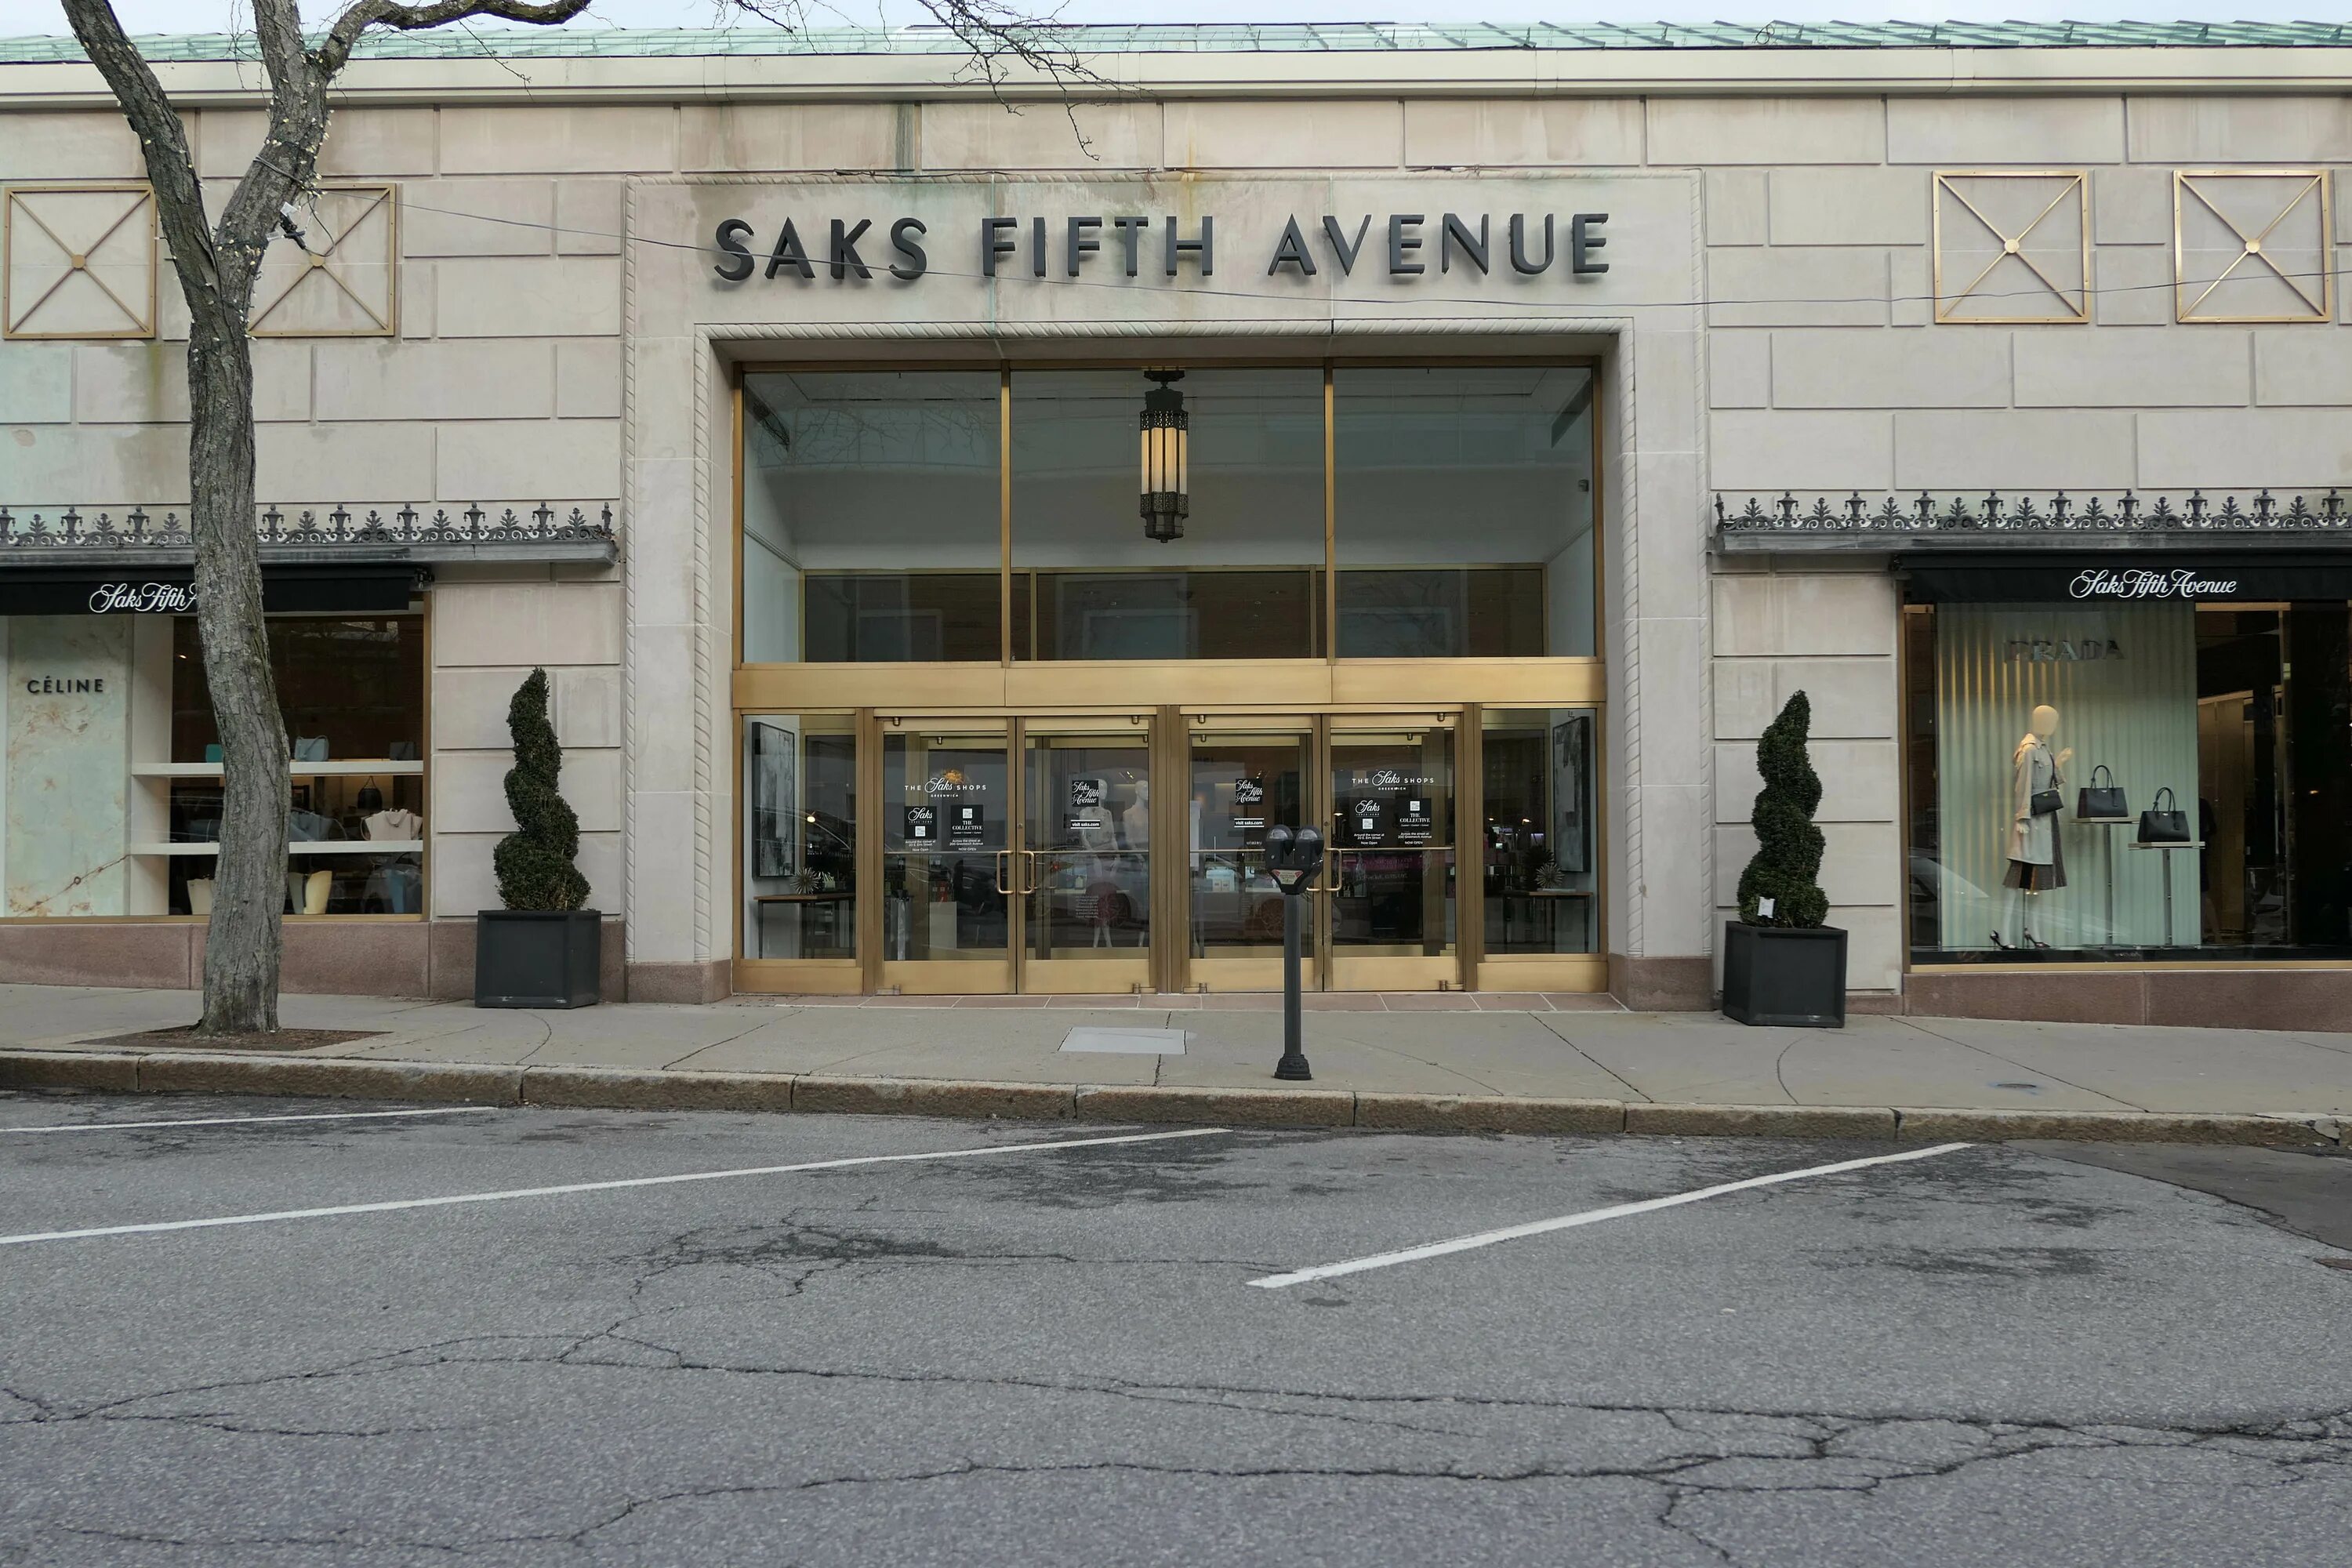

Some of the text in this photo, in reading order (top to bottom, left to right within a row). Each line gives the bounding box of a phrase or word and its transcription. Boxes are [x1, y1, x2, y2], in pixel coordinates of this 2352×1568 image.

[713, 212, 1610, 281] SAKS FIFTH AVENUE
[2069, 569, 2237, 598] Saks Fifth Avenue
[89, 583, 143, 613] Saks
[135, 583, 187, 612] Fifth
[27, 675, 103, 694] CÉLINE
[924, 777, 953, 793] Saks
[1371, 770, 1400, 786] Saks
[1073, 781, 1090, 793] Saks
[1236, 779, 1254, 792] Saks
[1073, 793, 1097, 805] Avenue
[1236, 792, 1261, 803] Avenue
[1356, 800, 1380, 813] Saks
[908, 808, 933, 821] Saks
